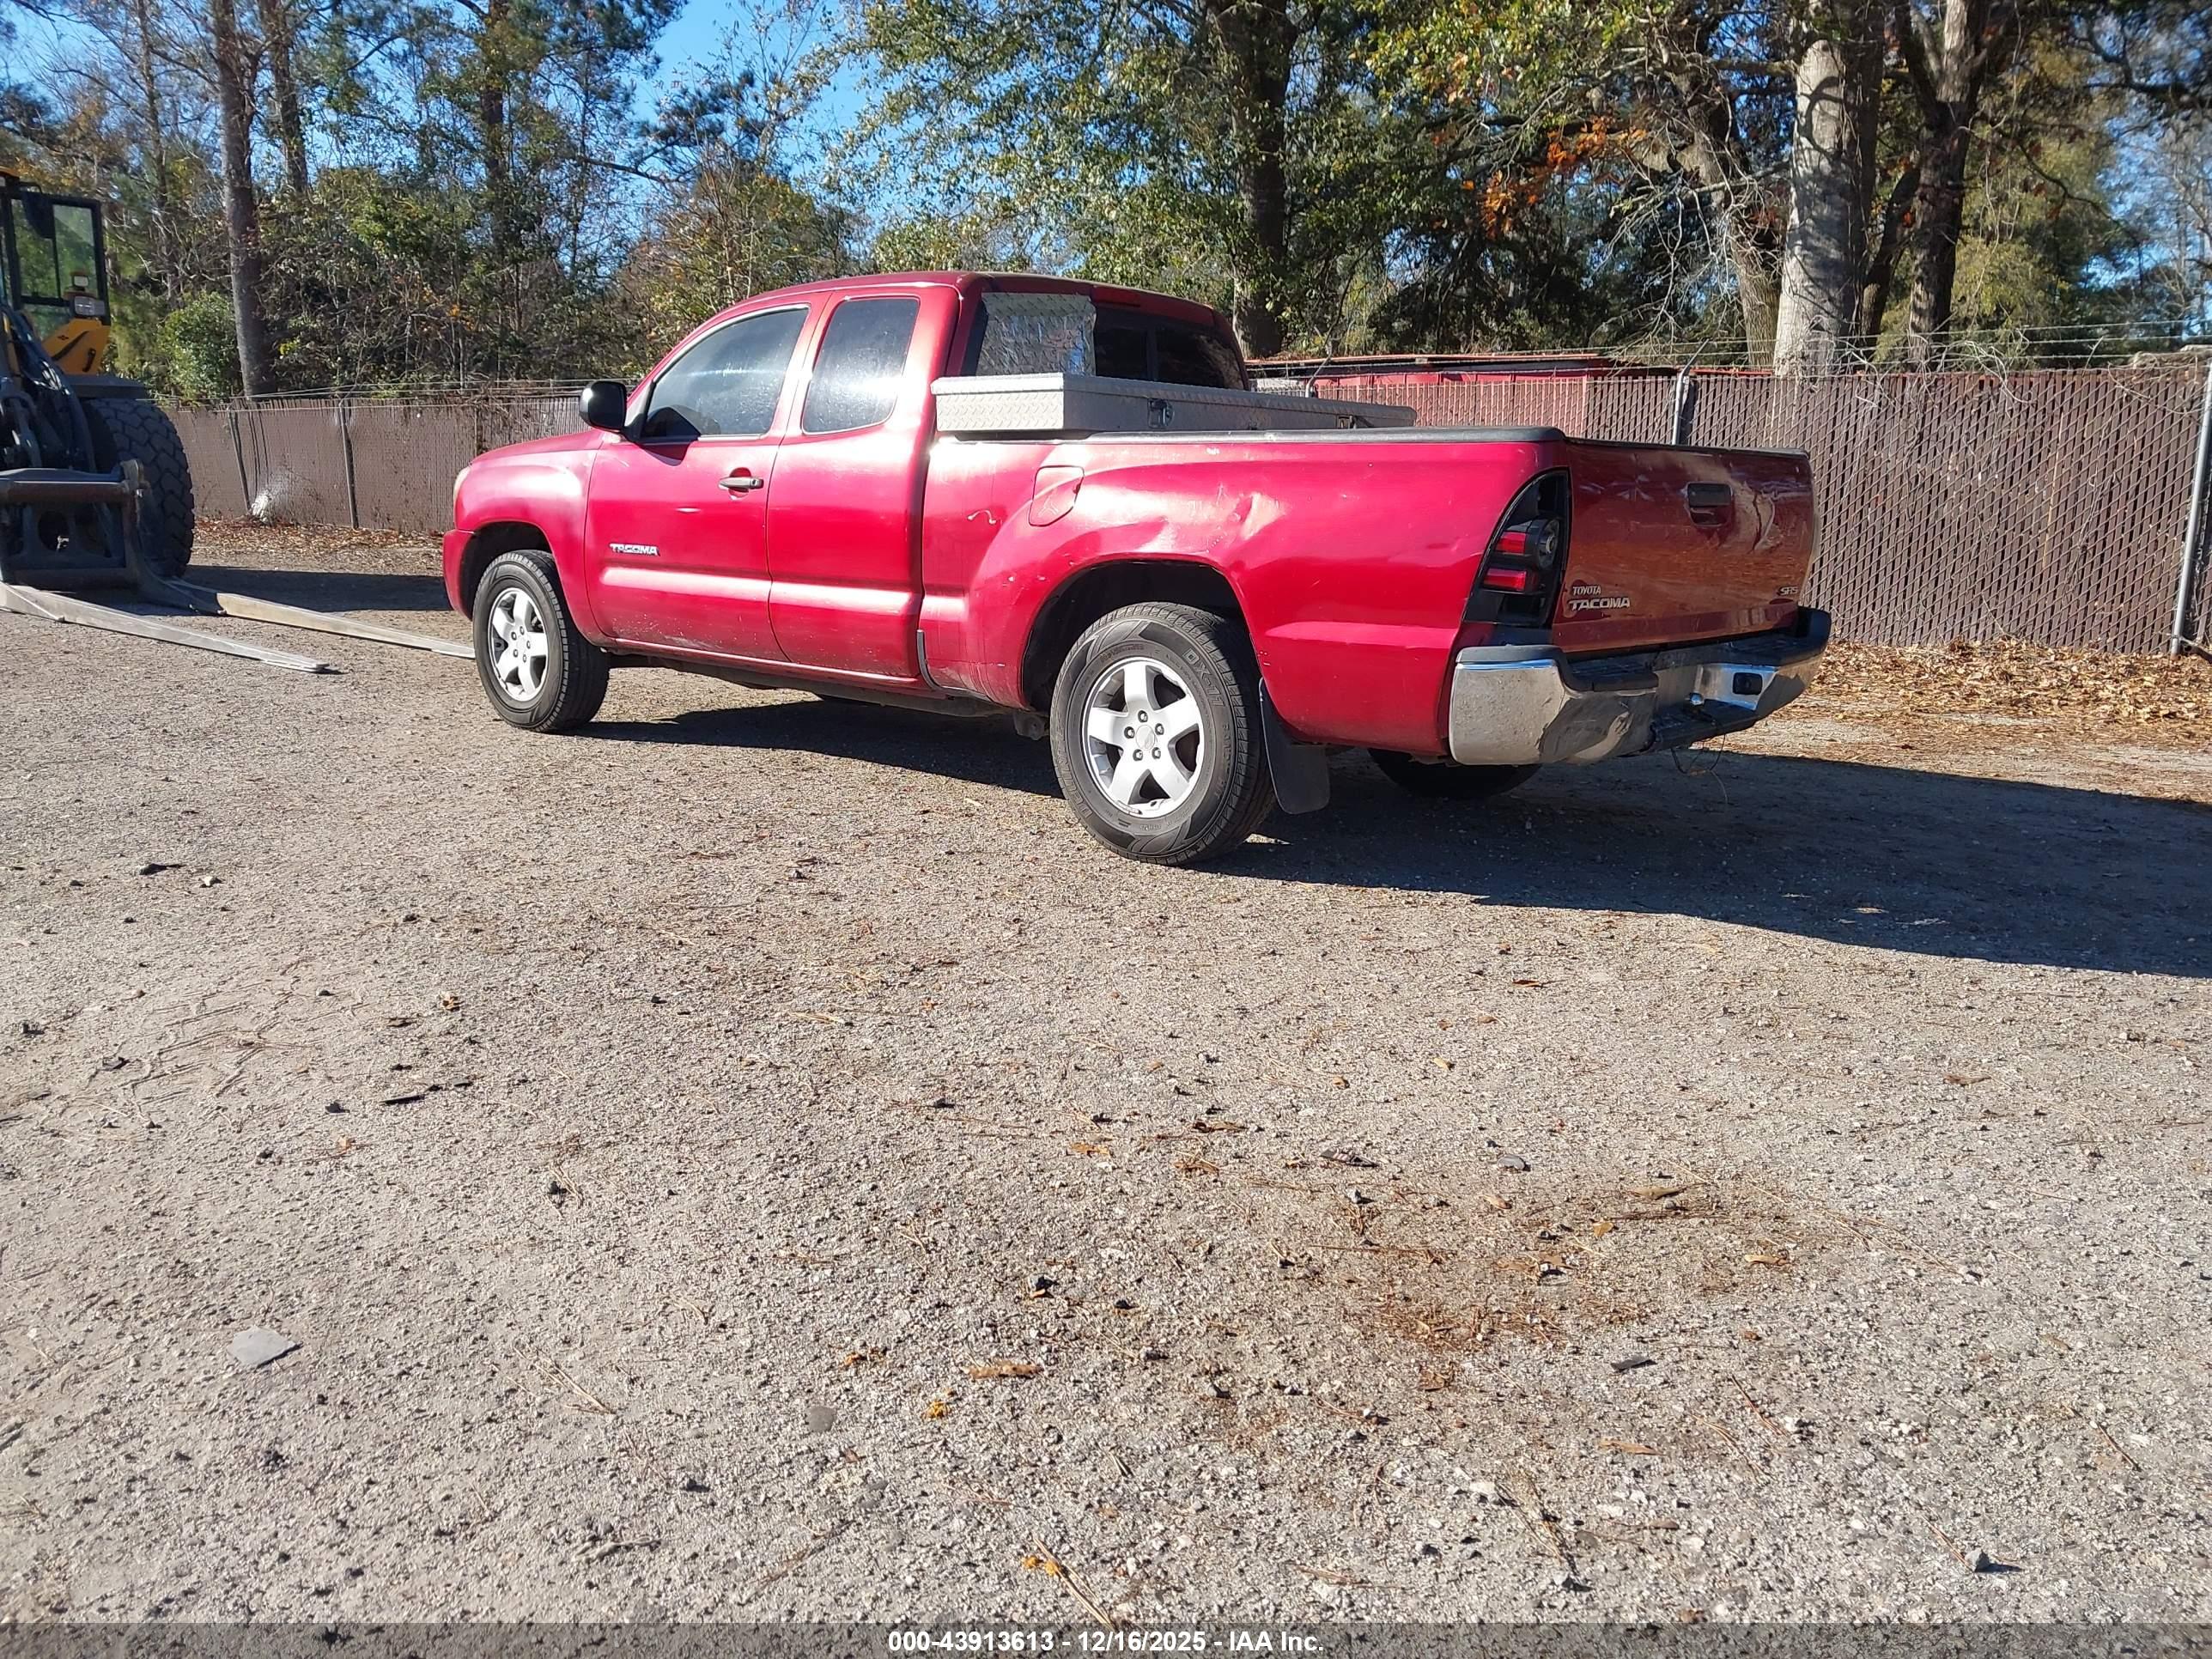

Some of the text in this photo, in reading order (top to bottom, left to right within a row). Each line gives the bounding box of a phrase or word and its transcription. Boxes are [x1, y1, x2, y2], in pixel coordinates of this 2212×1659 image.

[609, 543, 659, 556] TACOMA
[1572, 586, 1601, 596] TOYOTA
[1569, 597, 1631, 611] TACOMA
